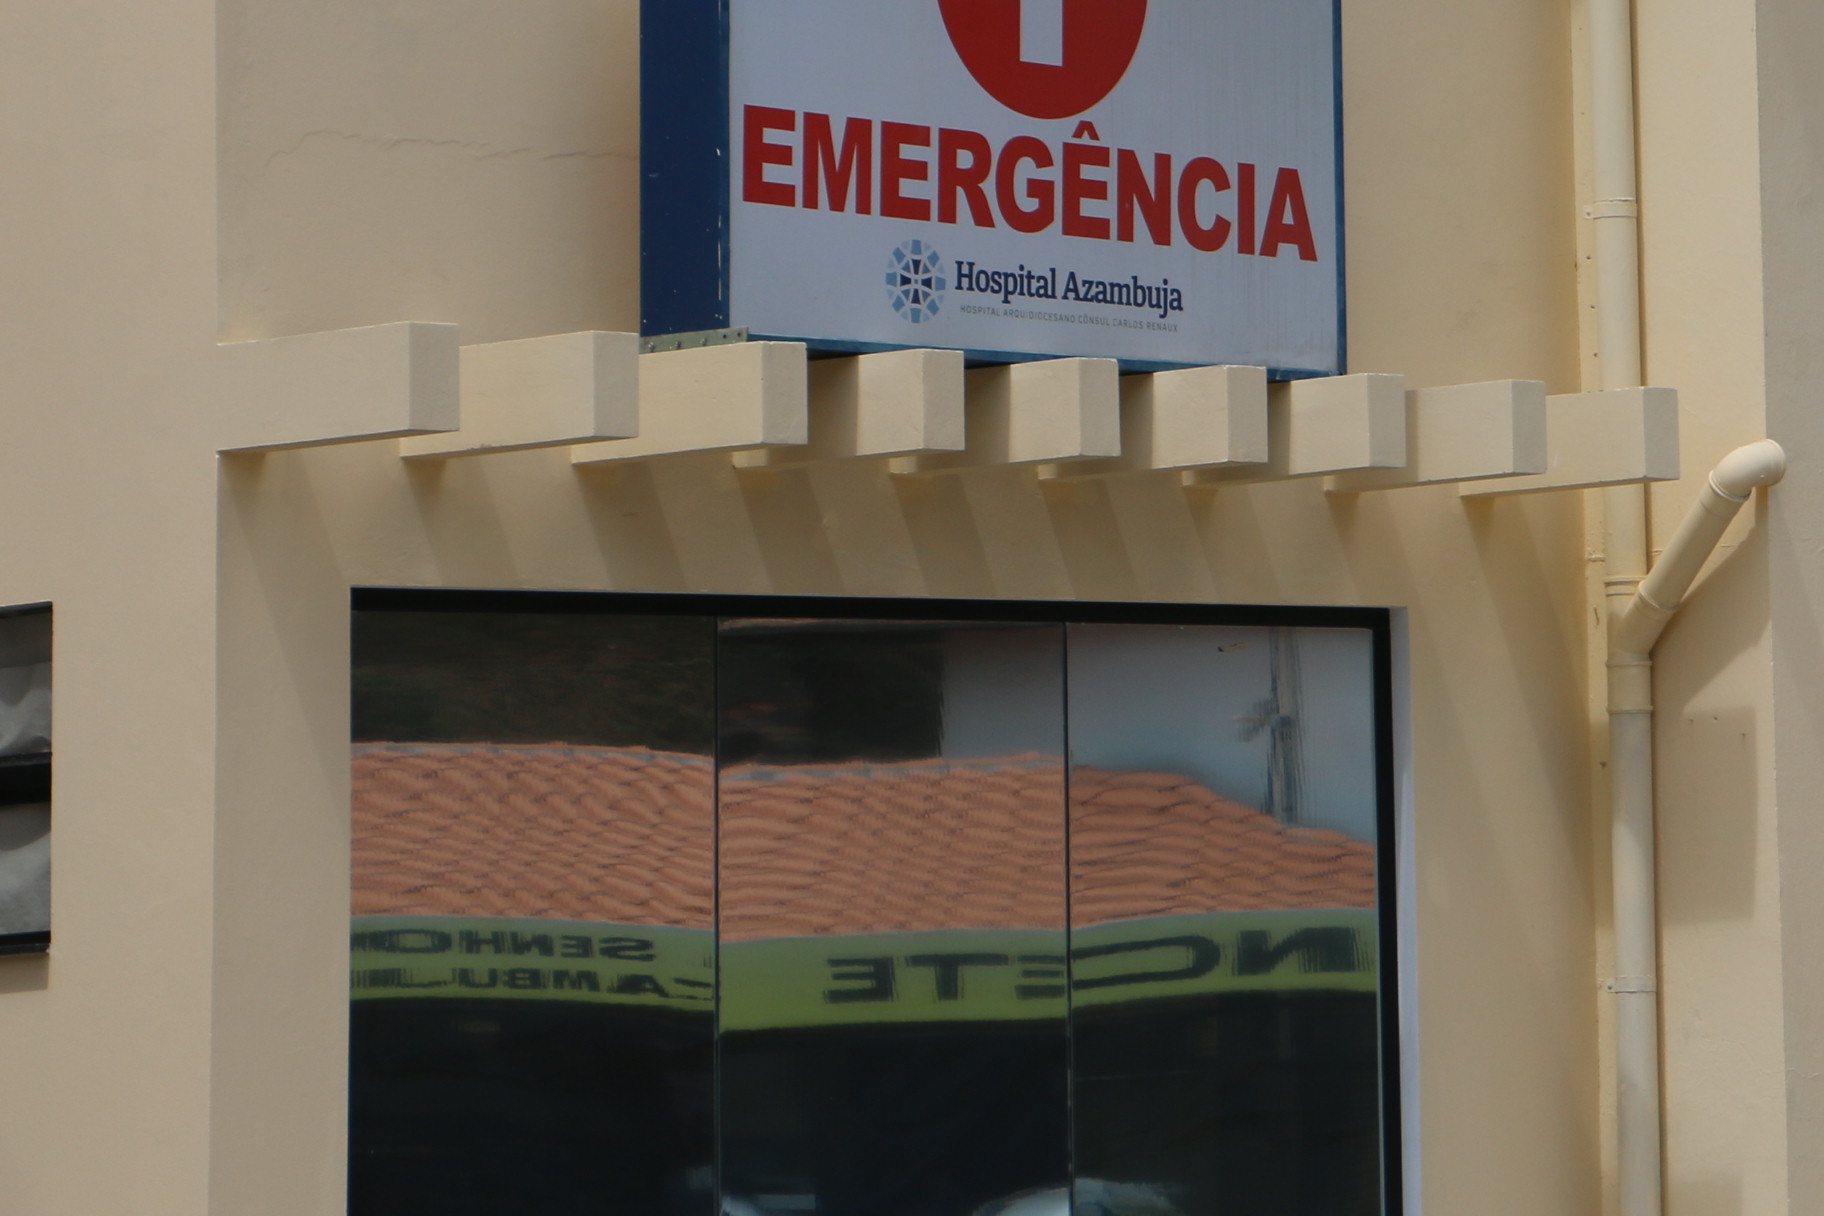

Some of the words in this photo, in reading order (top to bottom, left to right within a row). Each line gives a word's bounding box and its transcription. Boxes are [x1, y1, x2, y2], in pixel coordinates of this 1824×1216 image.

[742, 103, 1318, 262] EMERGÊNCIA
[955, 260, 1056, 305] Hospital
[1062, 271, 1183, 318] Azambuja
[960, 304, 1001, 317] HOSPITAL
[1003, 309, 1075, 324] ARQUIDIOCESANO
[1078, 313, 1110, 327] CÔNSUL
[1113, 318, 1143, 330] CARLOS
[1146, 321, 1178, 333] RENAUX
